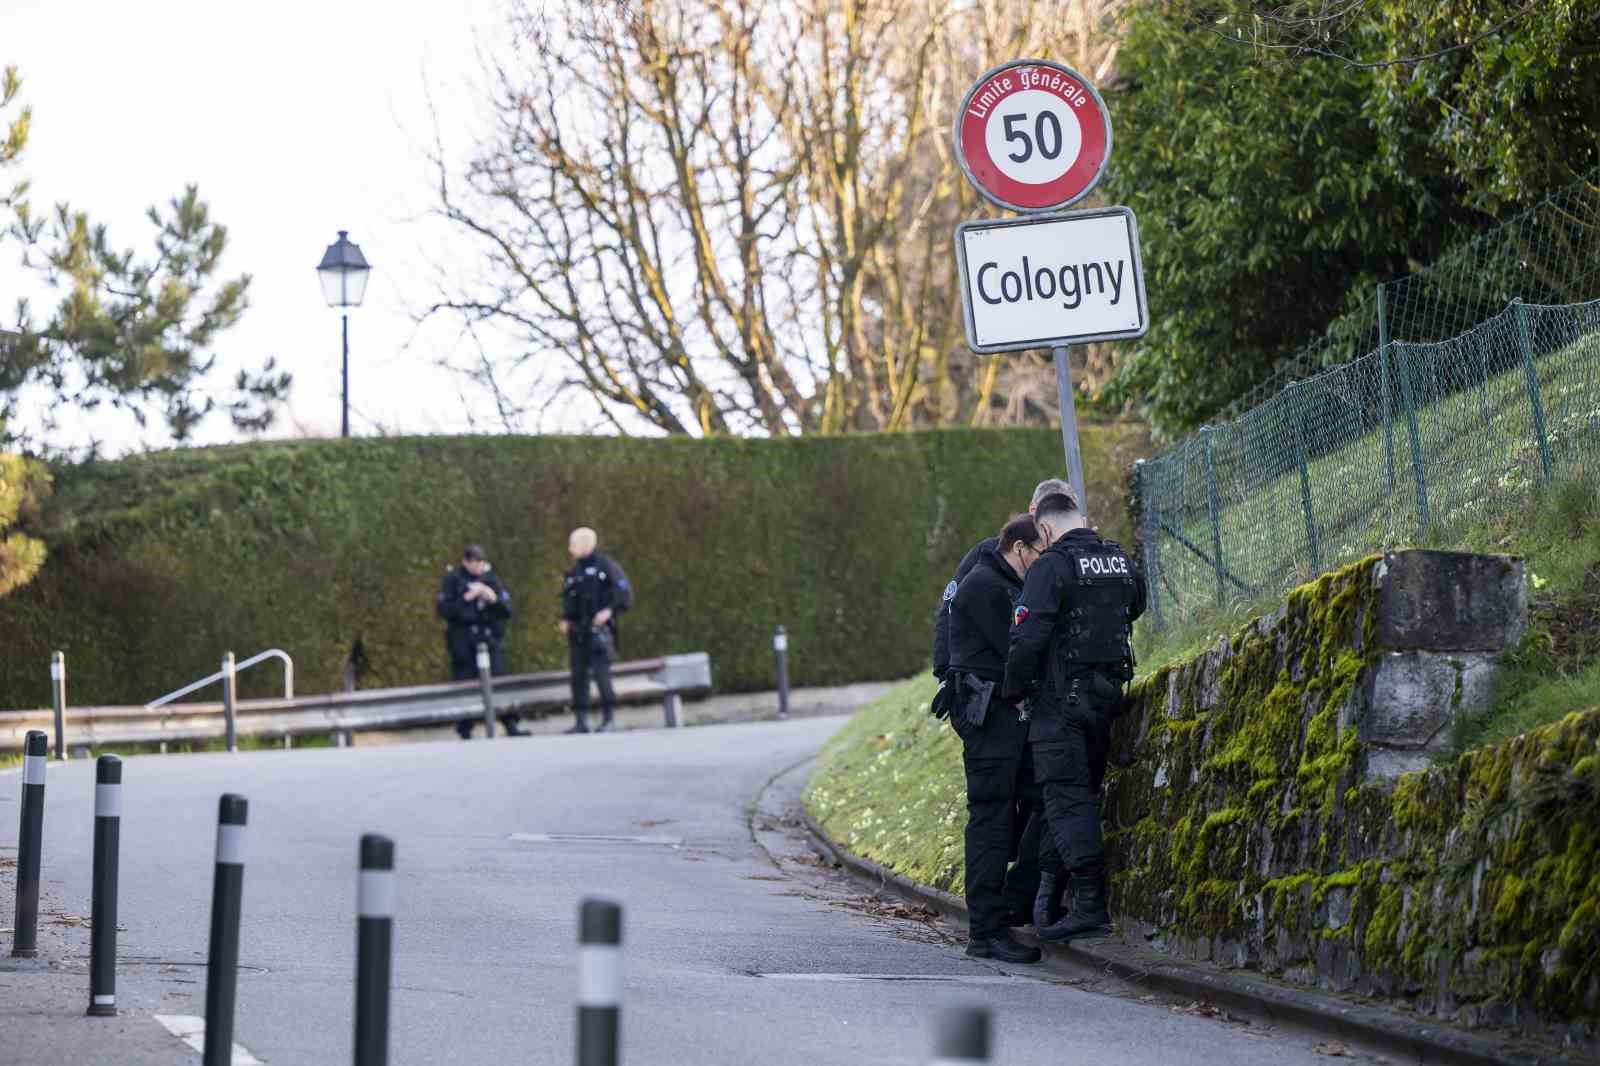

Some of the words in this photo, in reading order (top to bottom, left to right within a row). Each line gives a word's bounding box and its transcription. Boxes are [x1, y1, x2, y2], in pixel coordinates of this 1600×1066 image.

[968, 78, 1013, 119] Limite
[1020, 68, 1087, 107] générale
[1002, 110, 1062, 164] 50
[977, 256, 1124, 310] Cologny
[1079, 556, 1128, 575] POLICE
